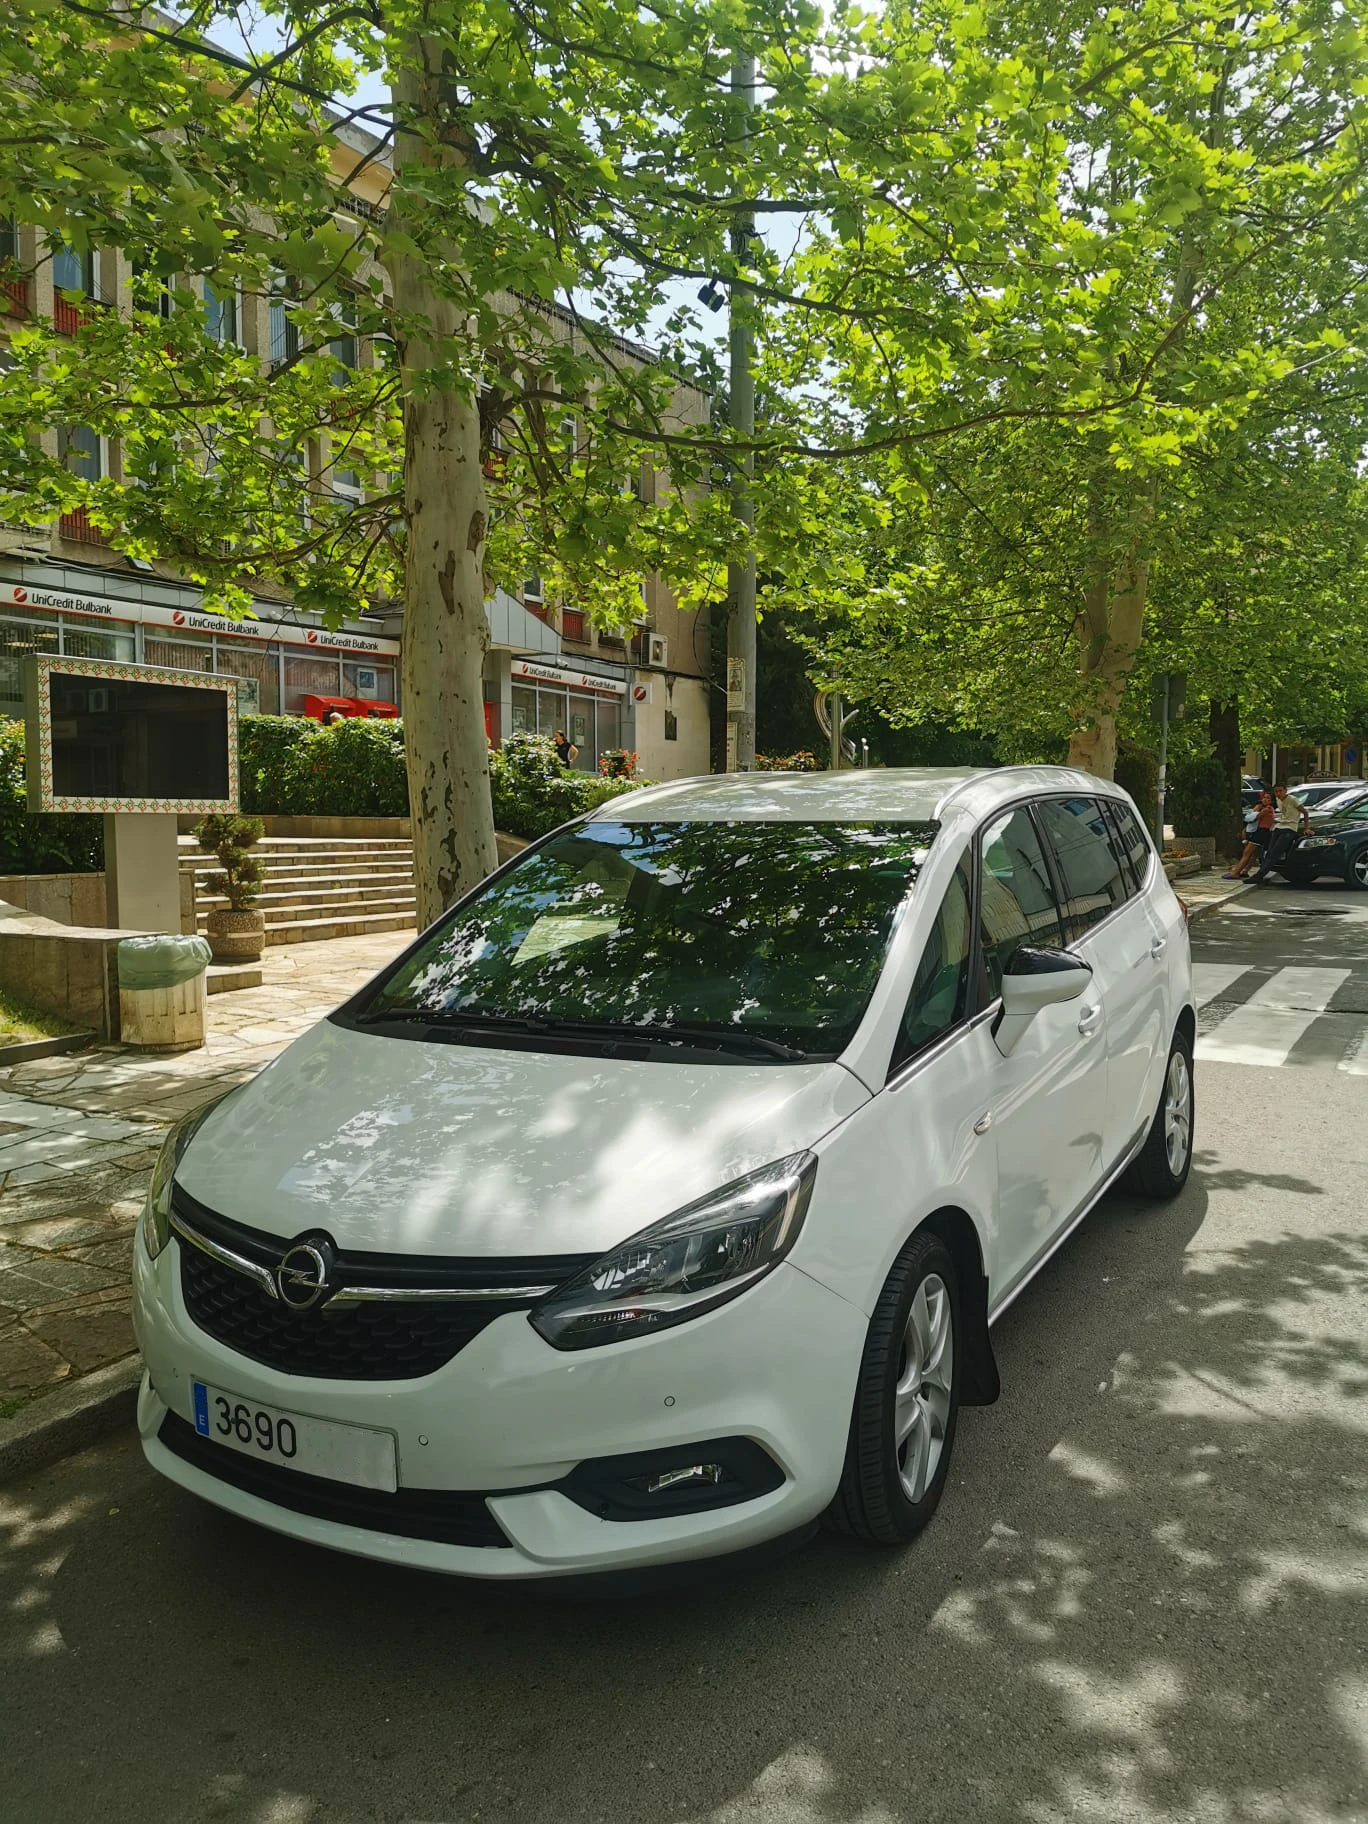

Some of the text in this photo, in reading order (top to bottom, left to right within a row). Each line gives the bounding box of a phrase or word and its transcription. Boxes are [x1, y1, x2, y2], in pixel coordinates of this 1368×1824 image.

[31, 592, 112, 615] UniCredit Bulbank
[189, 616, 259, 636] UniCredit Bulbank
[320, 634, 379, 651] UniCredit Bulbank
[199, 1396, 297, 1458] E 3690
